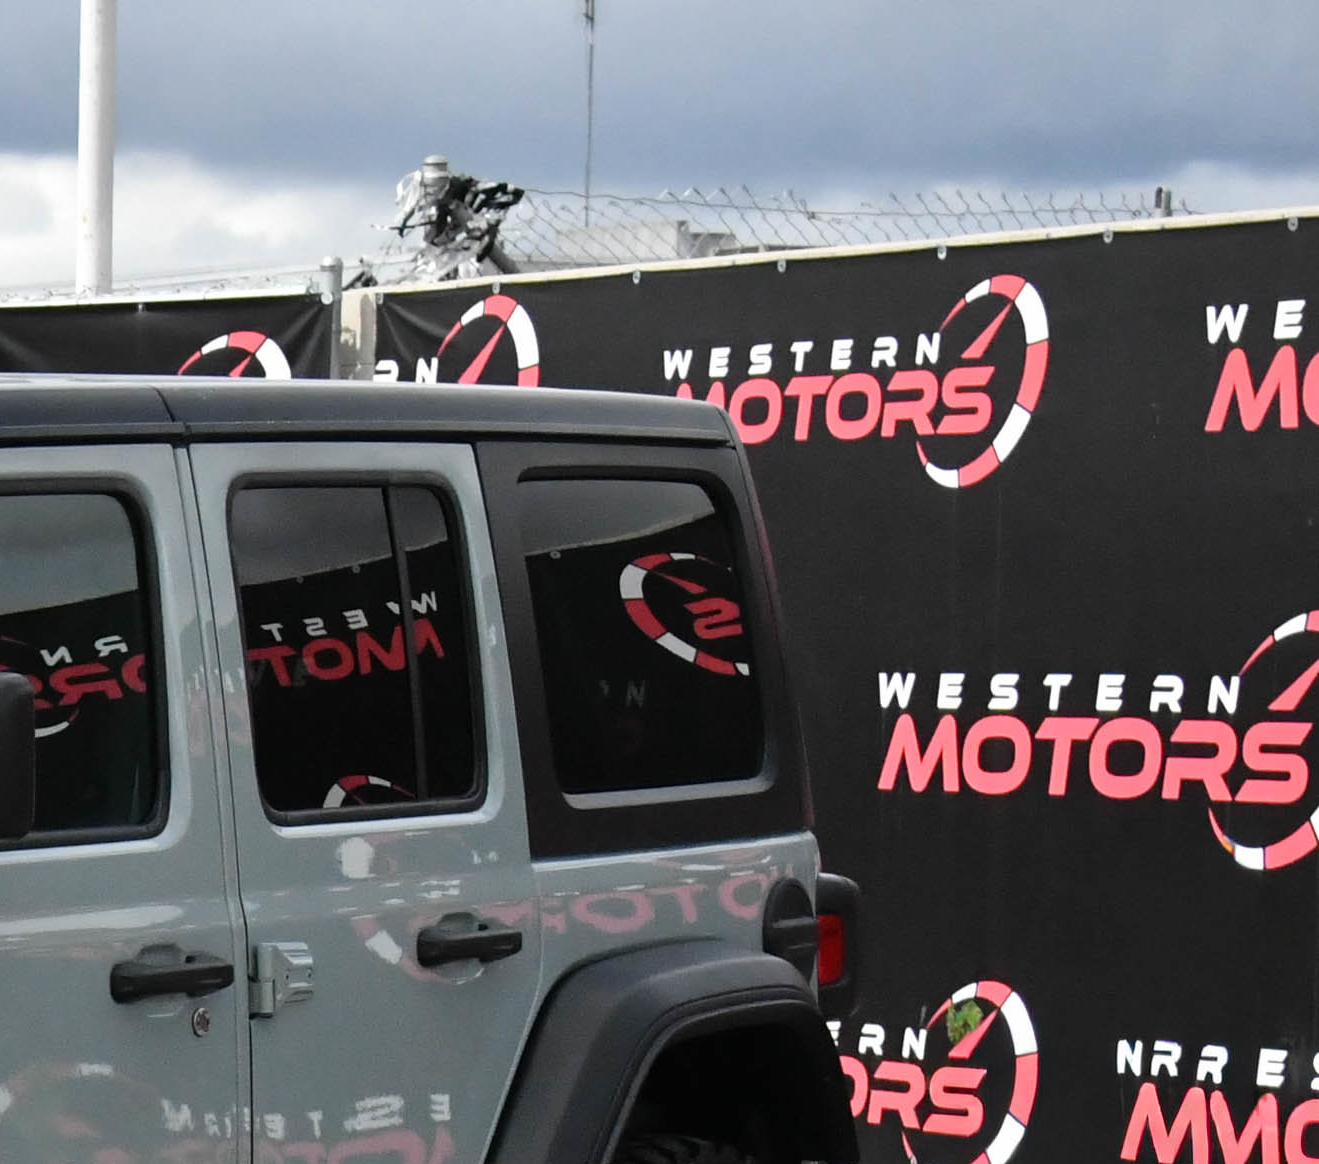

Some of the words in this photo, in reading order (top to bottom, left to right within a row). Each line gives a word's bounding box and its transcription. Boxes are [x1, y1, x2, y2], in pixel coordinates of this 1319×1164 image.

[663, 332, 940, 381] WESTERN
[1204, 344, 1319, 434] M
[878, 671, 1241, 714] WESTERN
[877, 713, 1313, 804] MOTORS
